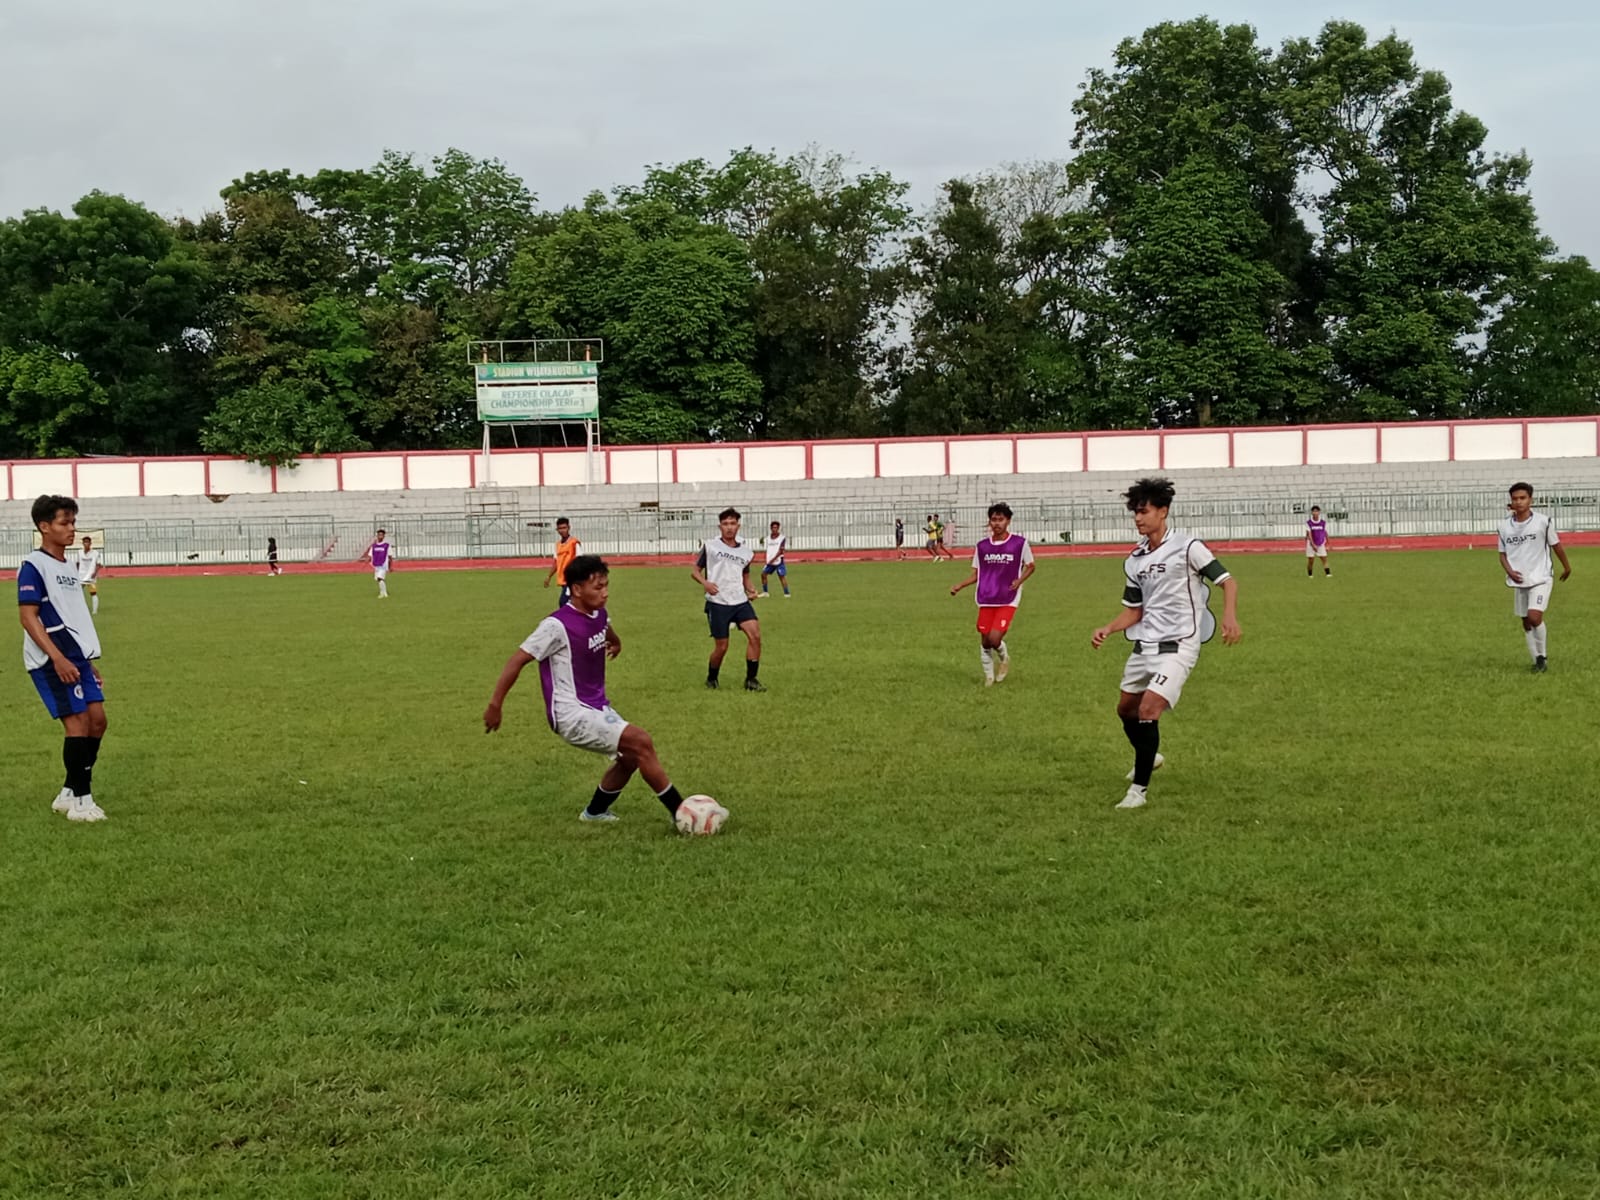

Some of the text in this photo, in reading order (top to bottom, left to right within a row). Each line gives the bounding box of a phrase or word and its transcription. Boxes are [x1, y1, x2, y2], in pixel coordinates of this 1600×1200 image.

[502, 389, 575, 399] REFEREE CILACAP
[491, 399, 553, 409] CHAMPIONSHIP
[1155, 673, 1169, 686] 17
